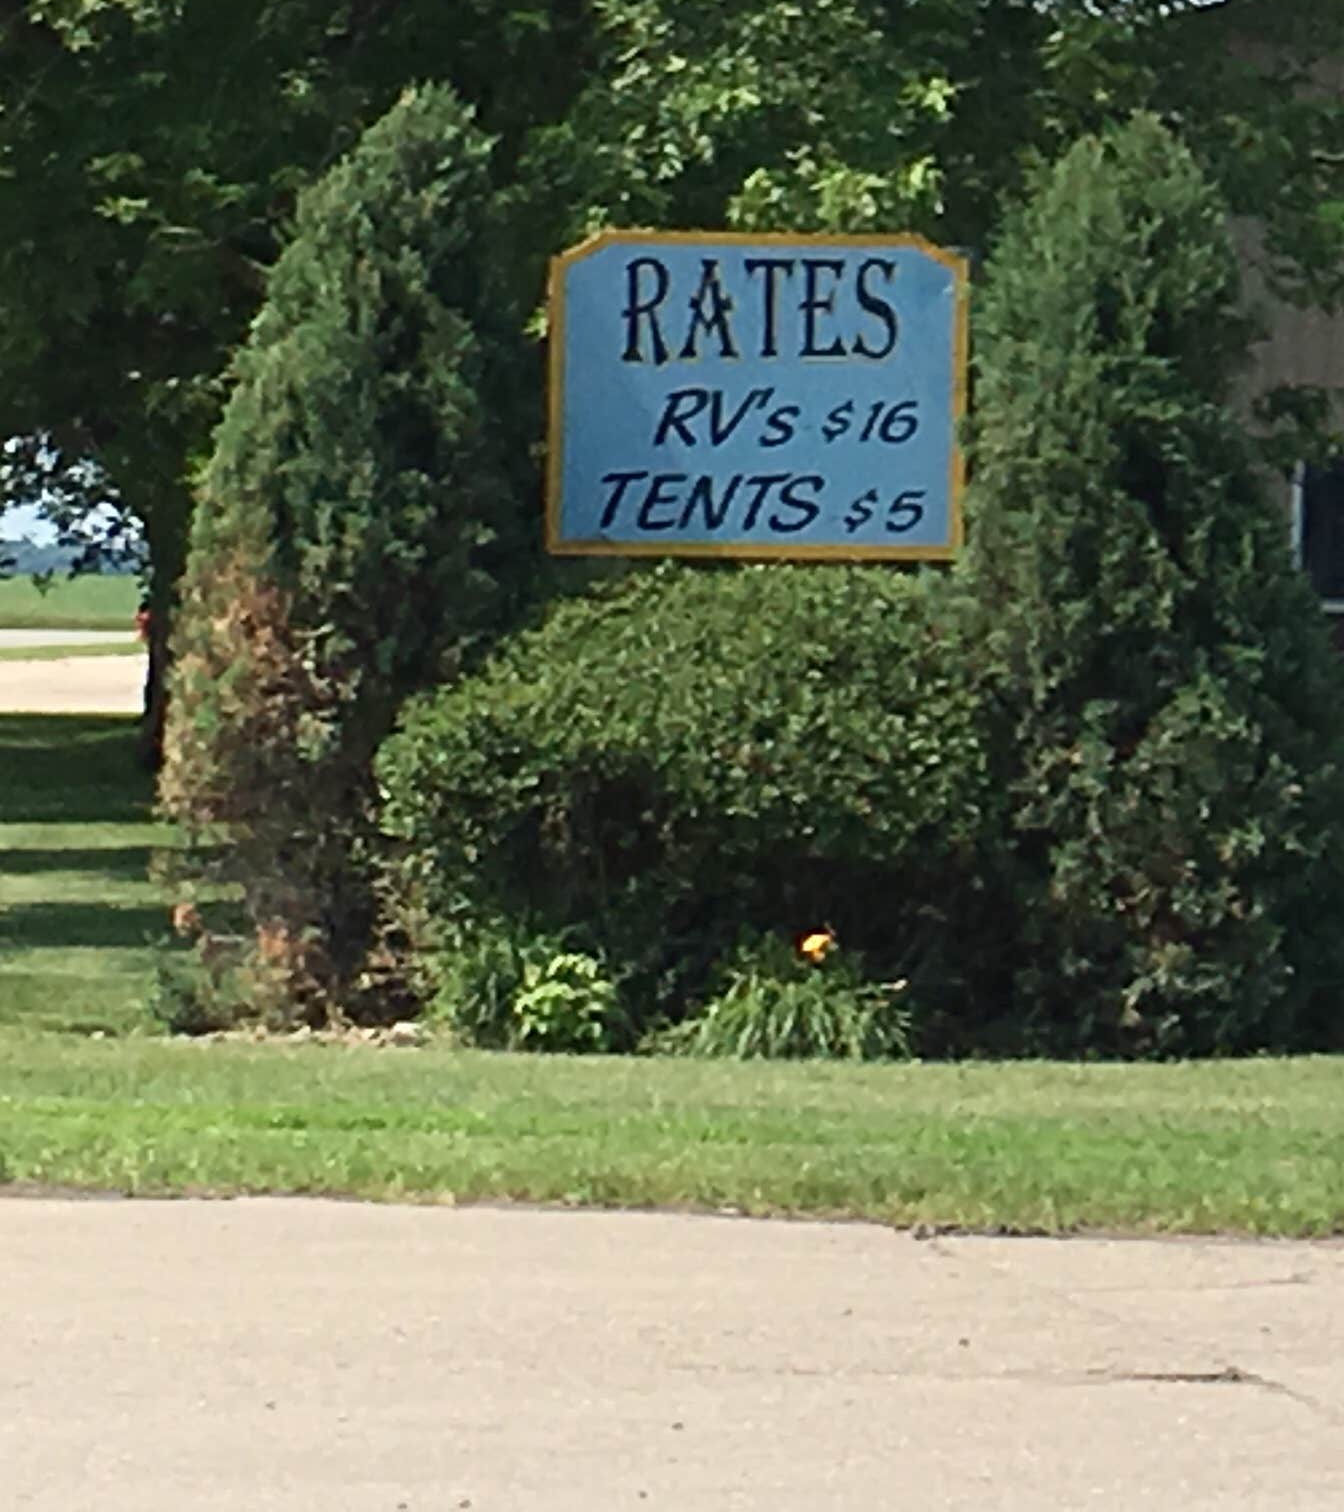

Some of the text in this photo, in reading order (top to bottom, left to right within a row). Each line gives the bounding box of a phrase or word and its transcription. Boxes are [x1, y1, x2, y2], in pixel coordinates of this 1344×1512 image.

[621, 257, 898, 366] RATES
[653, 387, 919, 448] RV's $16
[600, 471, 927, 534] TENTS $5
